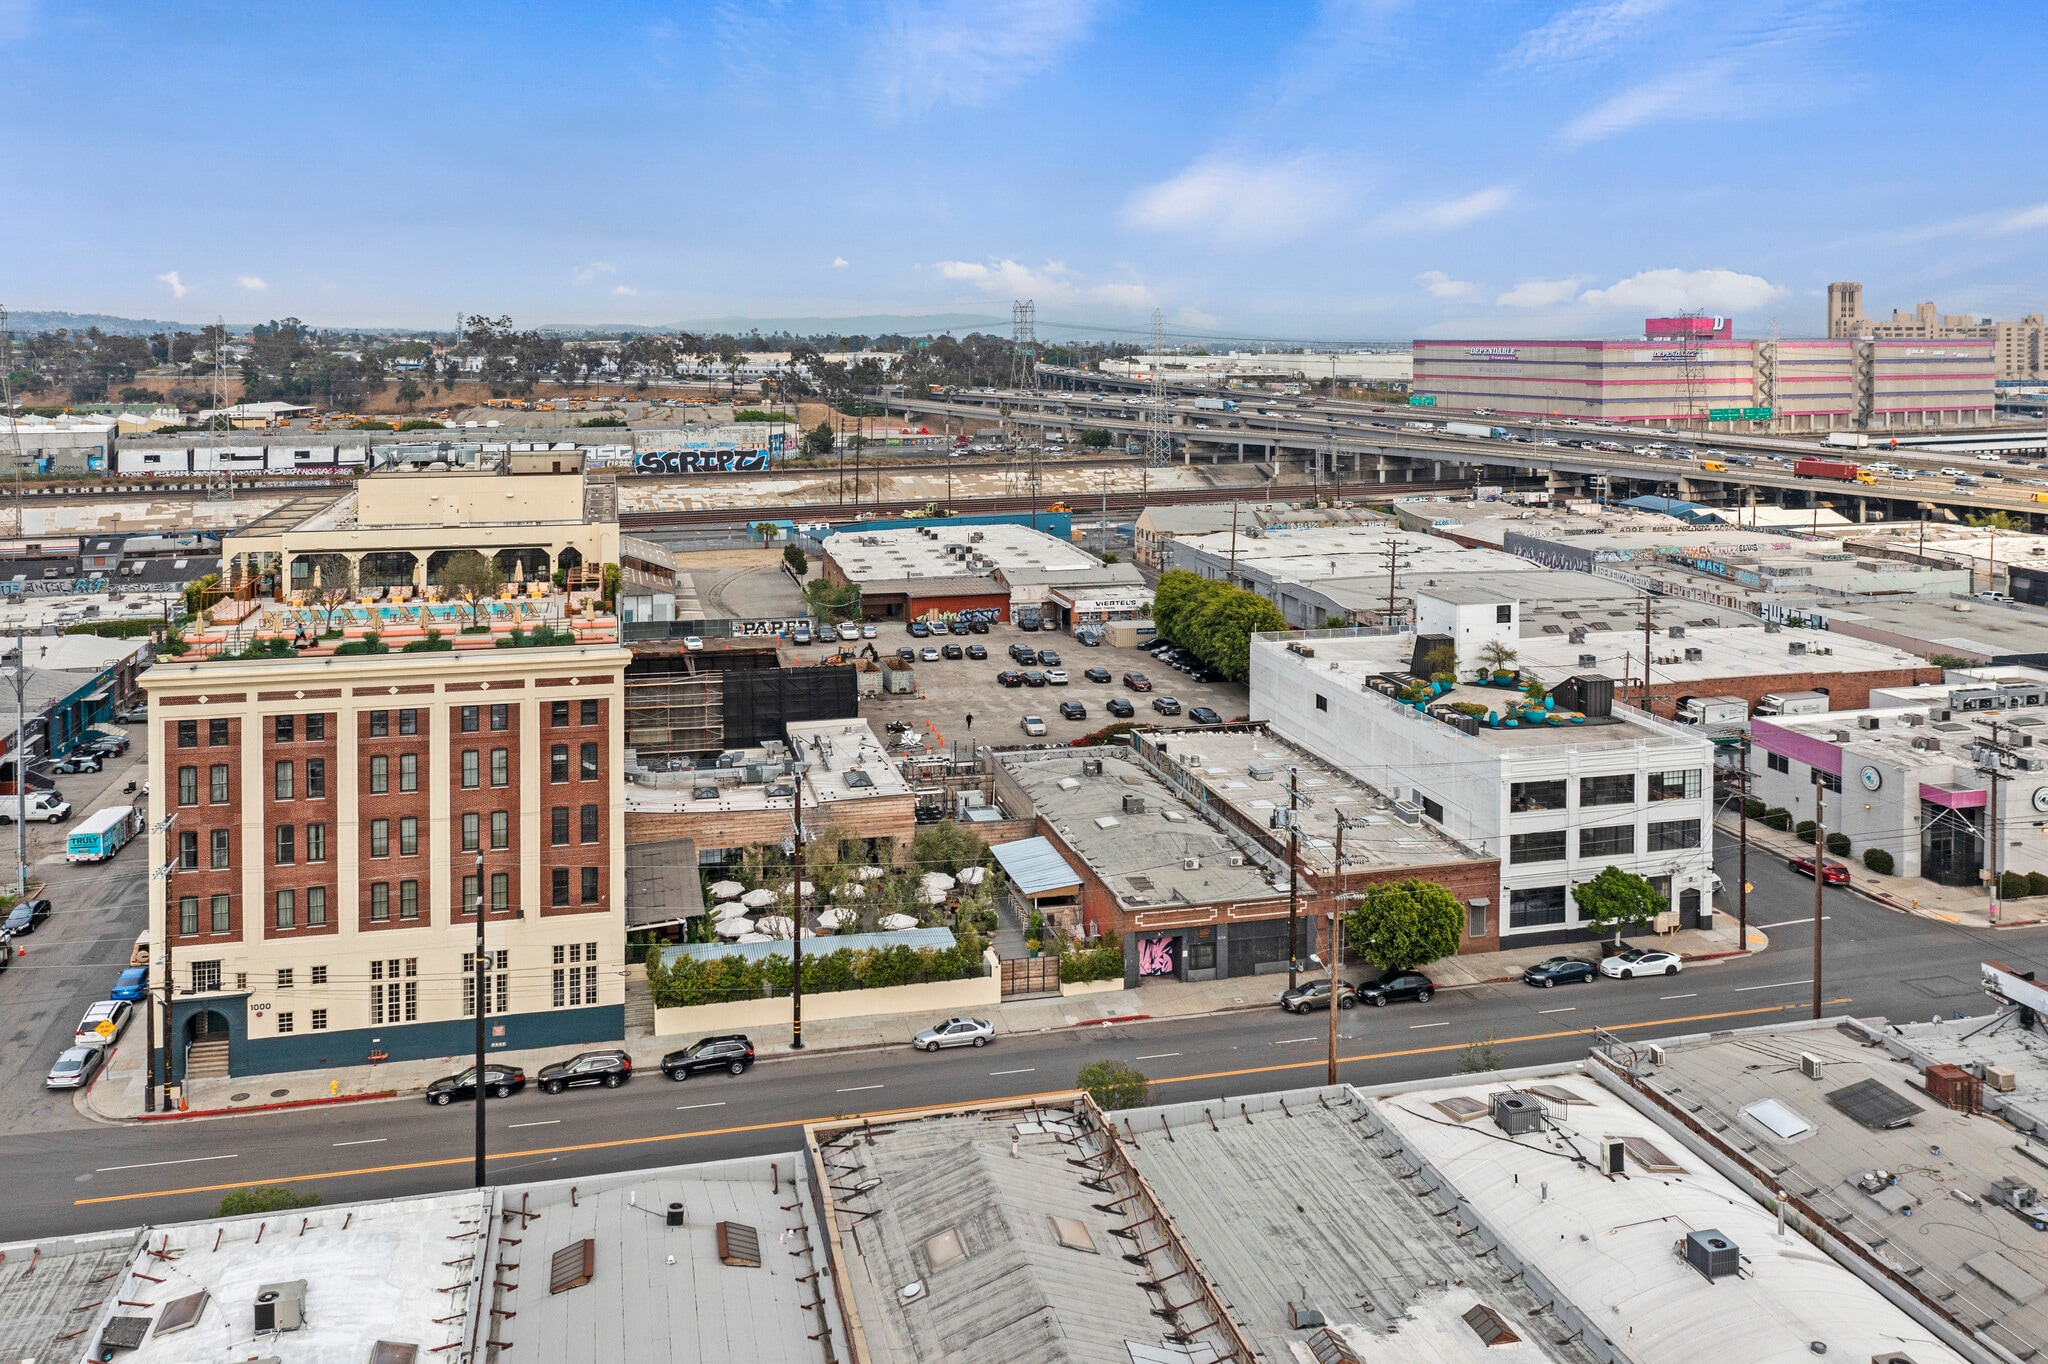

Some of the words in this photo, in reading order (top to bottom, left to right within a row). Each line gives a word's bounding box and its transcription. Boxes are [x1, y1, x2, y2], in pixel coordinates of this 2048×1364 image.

[1712, 316, 1725, 331] D
[1470, 347, 1516, 356] DEPENDABLE
[635, 449, 768, 474] SCRIPT
[73, 578, 109, 593] RIP
[71, 837, 98, 845] TRULY
[250, 1003, 272, 1011] 1000
